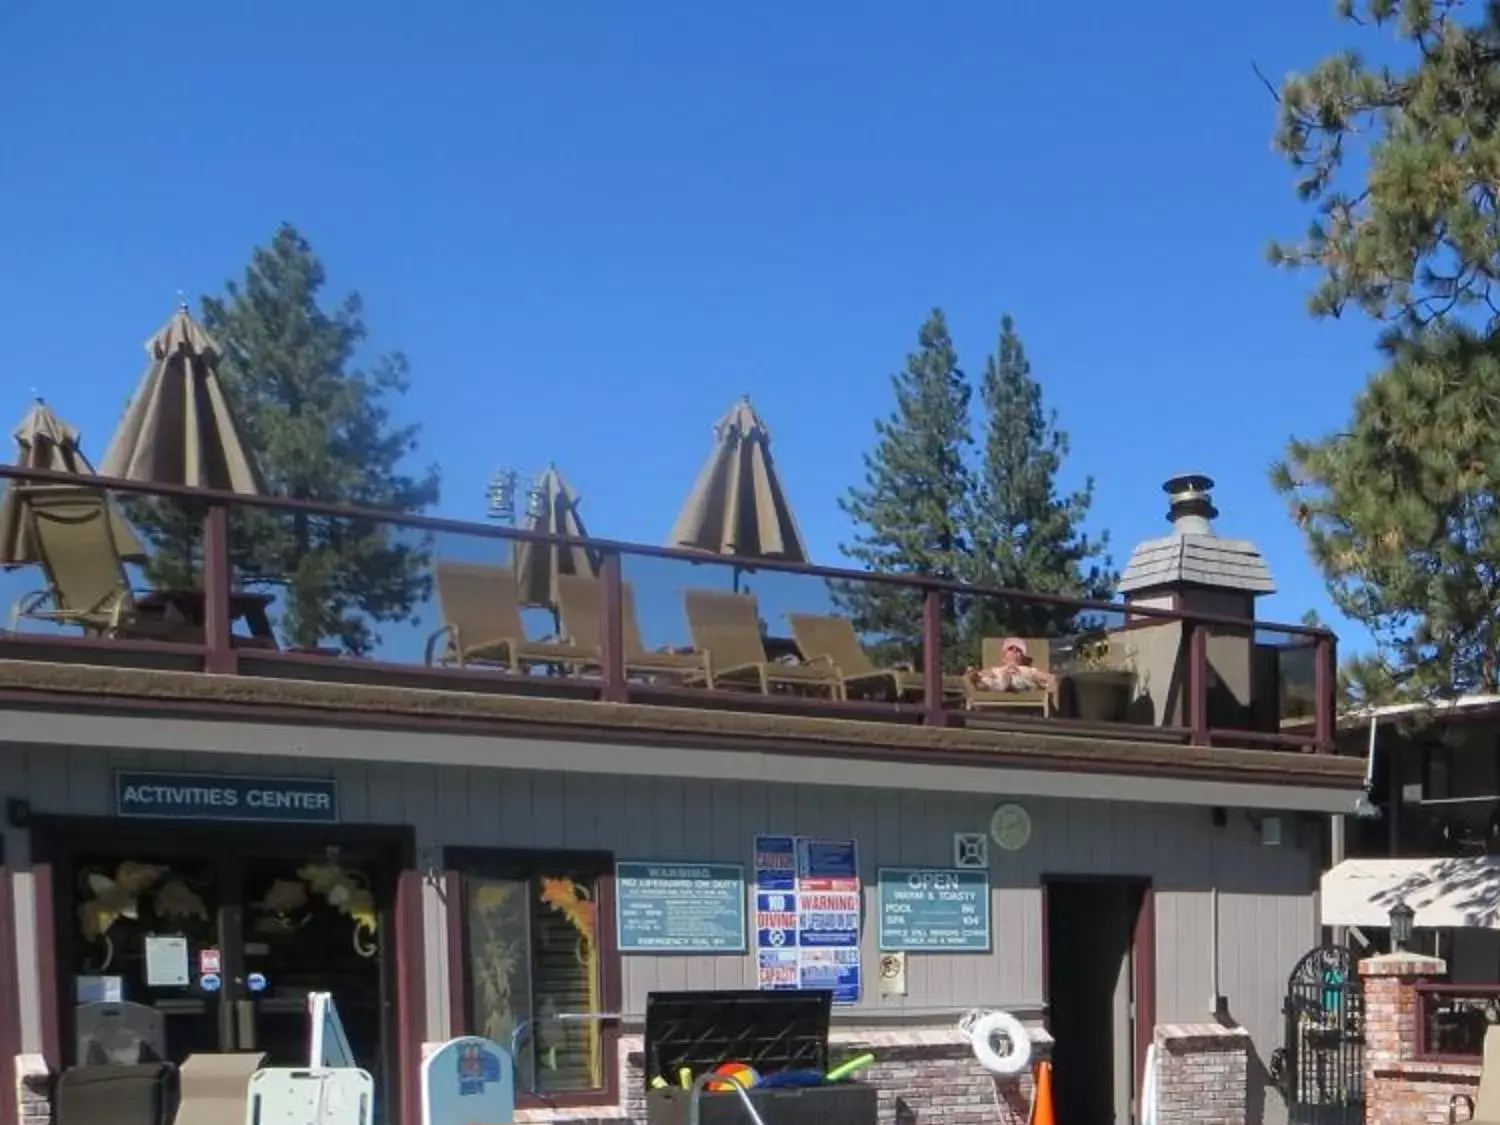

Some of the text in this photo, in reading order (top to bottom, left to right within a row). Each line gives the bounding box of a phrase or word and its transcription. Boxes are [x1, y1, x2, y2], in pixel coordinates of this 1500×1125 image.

[124, 785, 330, 809] ACTIVITIES CENTER
[648, 867, 711, 878] WARNING
[908, 873, 960, 890] OPEN
[757, 912, 797, 929] DIVING
